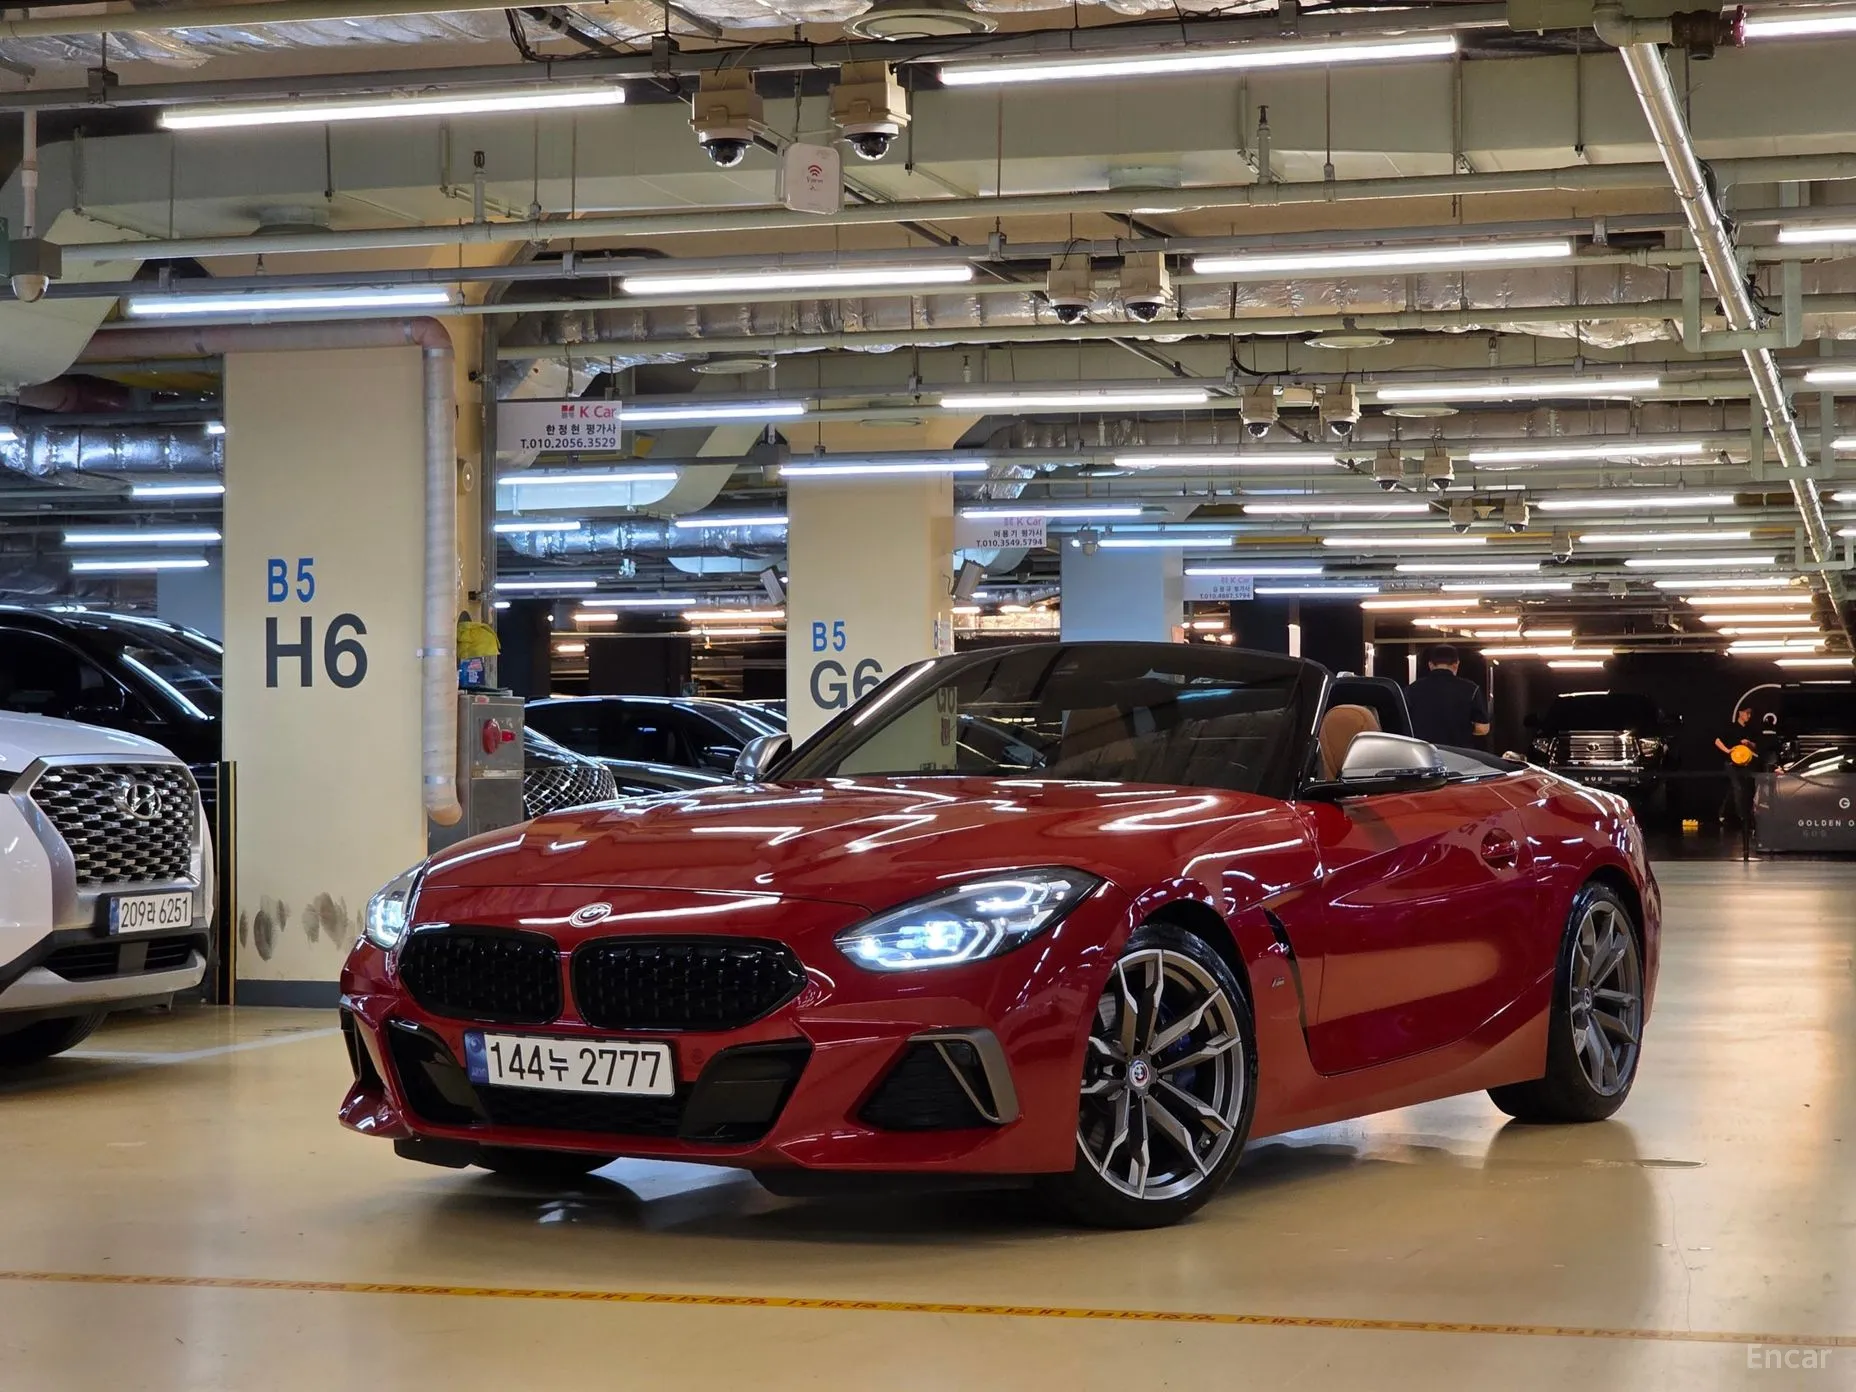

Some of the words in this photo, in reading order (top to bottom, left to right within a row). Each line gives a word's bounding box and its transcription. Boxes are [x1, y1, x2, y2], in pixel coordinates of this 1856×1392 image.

[580, 405, 589, 418] K
[594, 405, 617, 418] Car
[586, 424, 617, 436] 평가사
[521, 438, 616, 449] T.010.2056.3529
[1016, 517, 1024, 526] K
[1026, 517, 1042, 527] Car
[267, 557, 315, 603] B5
[812, 620, 847, 652] B5
[266, 613, 368, 689] H6
[1798, 819, 1842, 827] GOLDEN
[121, 900, 156, 928] 209라
[159, 897, 188, 924] 6251
[490, 1041, 570, 1083] 144누
[579, 1047, 661, 1088] 2777
